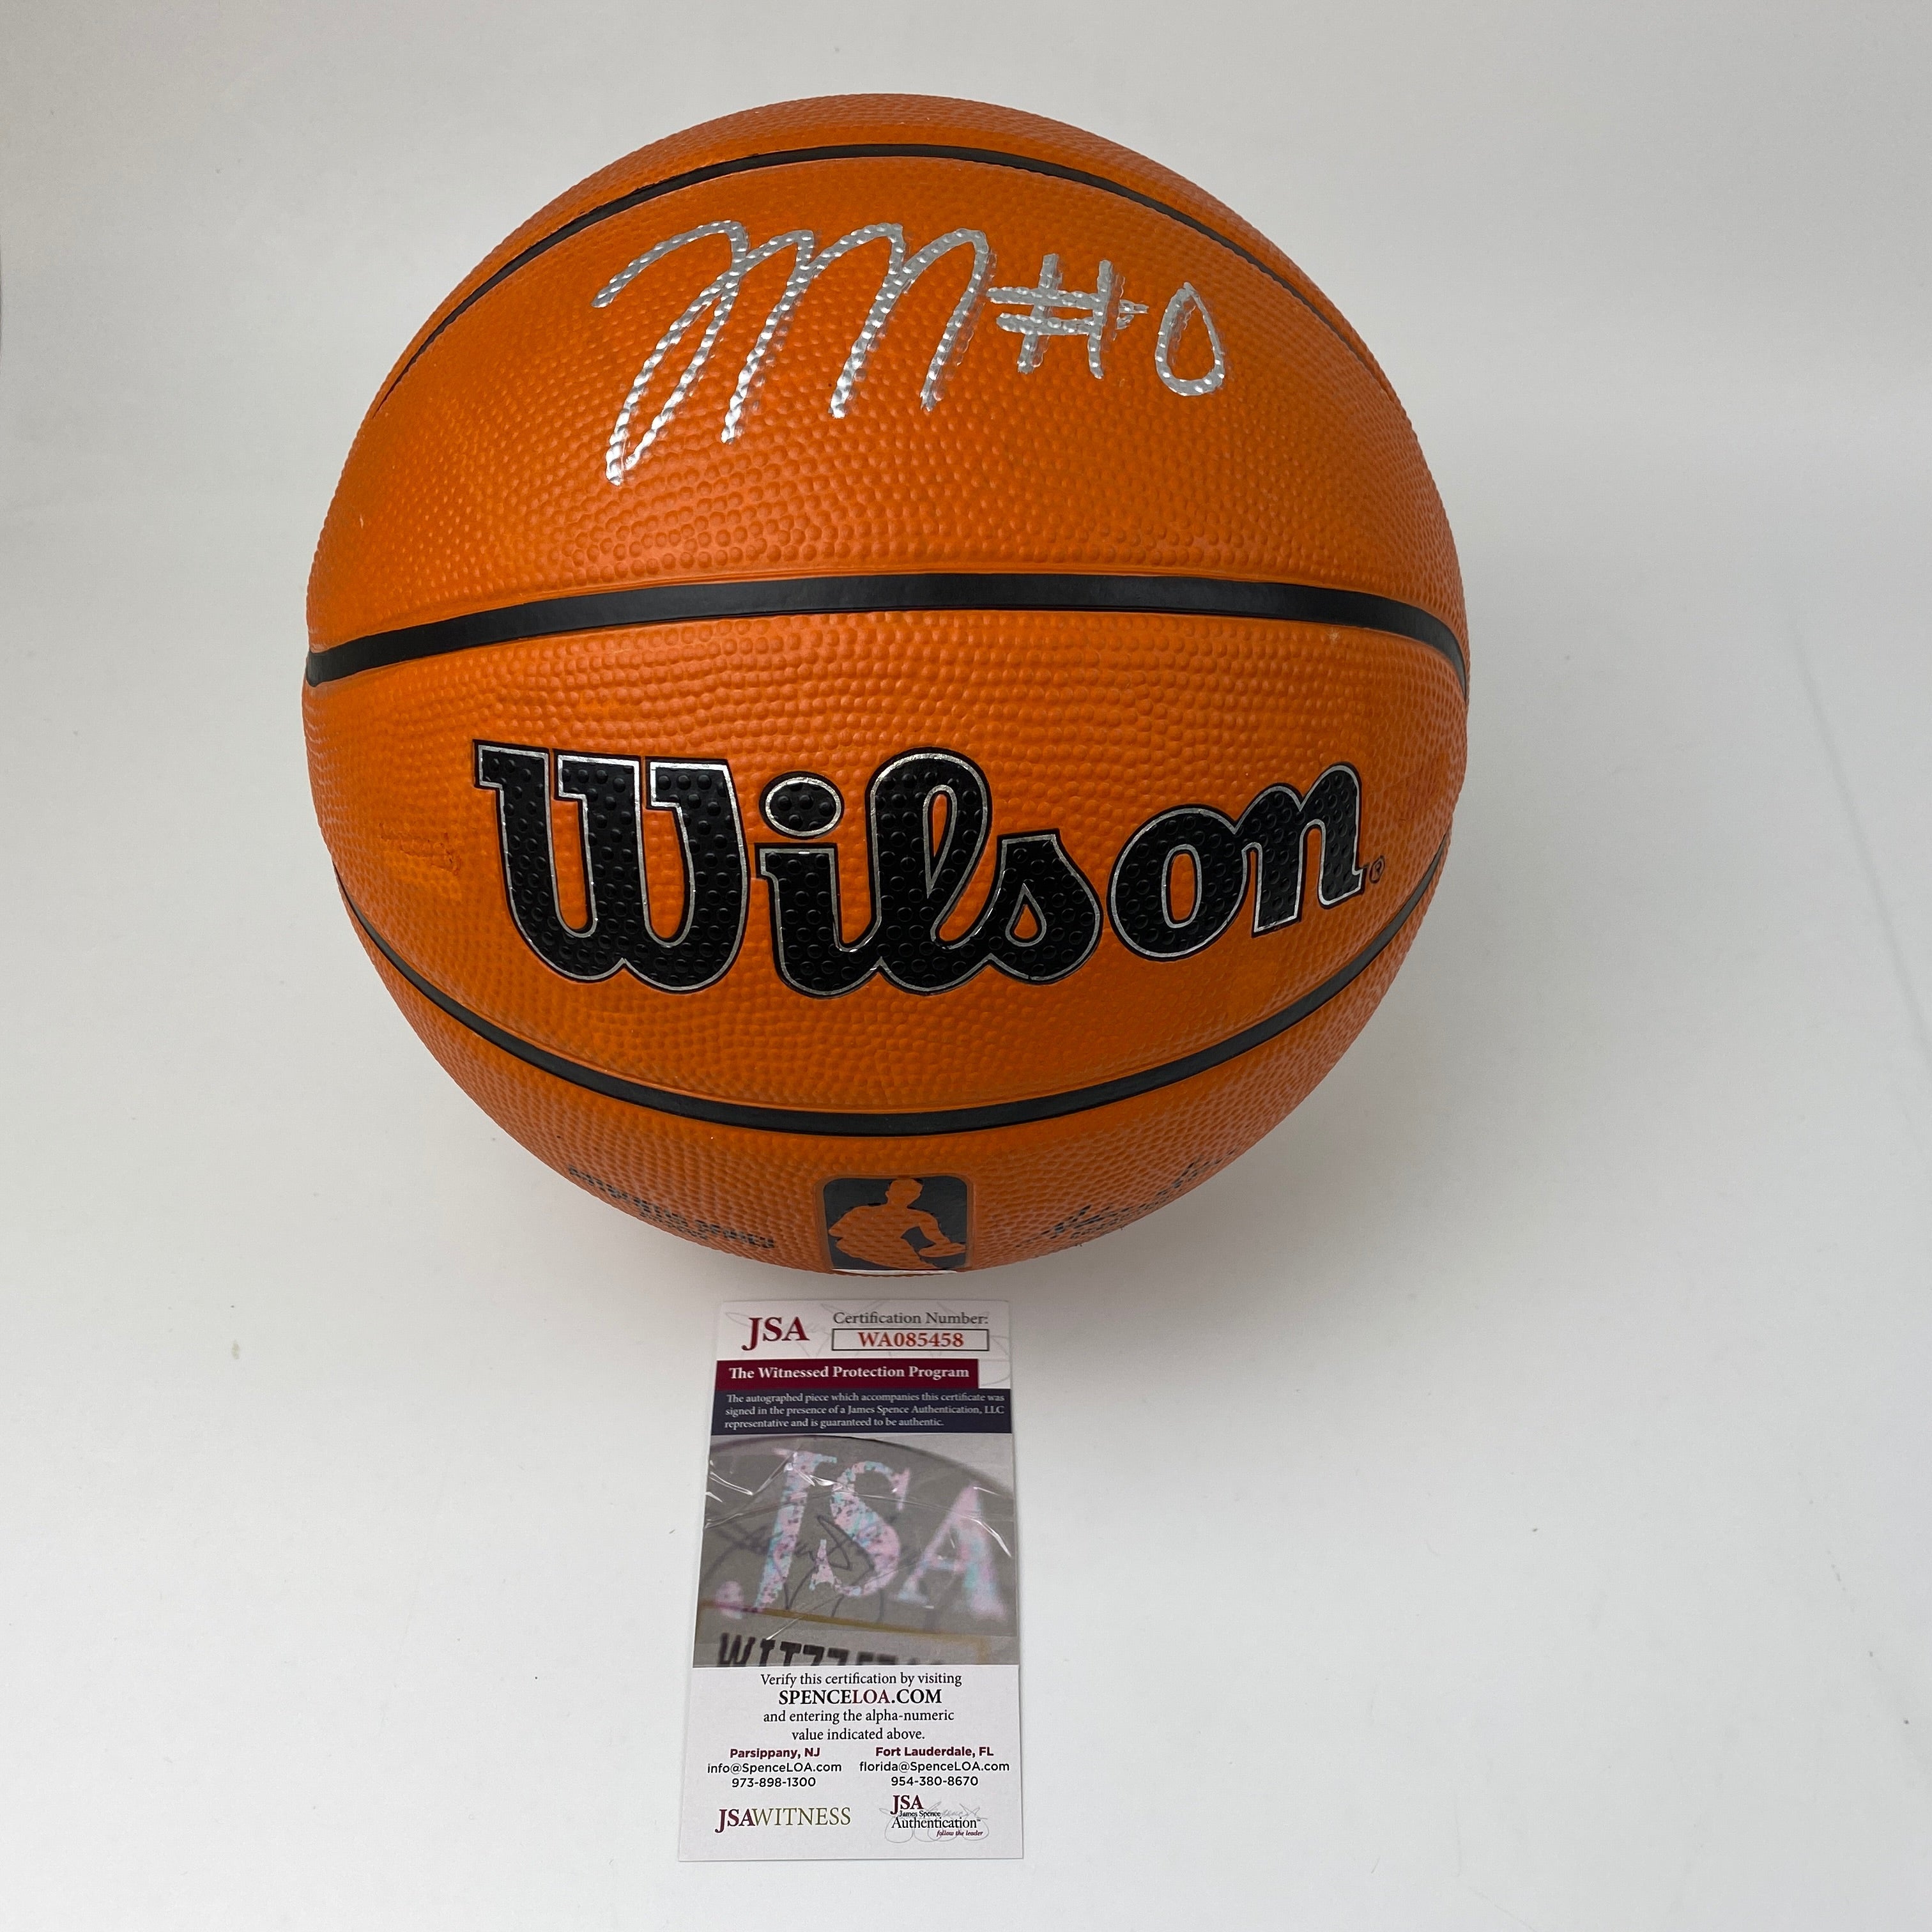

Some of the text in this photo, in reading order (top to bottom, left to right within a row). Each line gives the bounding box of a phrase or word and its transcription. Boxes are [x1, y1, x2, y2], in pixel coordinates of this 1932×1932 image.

[475, 740, 1366, 999] Wilson
[833, 1312, 988, 1324] Certification Number:
[741, 1317, 809, 1351] JSA
[857, 1331, 964, 1348] WA085458
[729, 1366, 969, 1380] The Witnessed Protection Program
[726, 1394, 744, 1402] The
[746, 1393, 802, 1404] autographed
[805, 1394, 829, 1404] piece
[831, 1393, 859, 1401] which
[861, 1393, 919, 1403] accompanies
[922, 1393, 939, 1401] this
[940, 1393, 986, 1401] certificate
[726, 1406, 755, 1418] signed
[758, 1407, 767, 1415] in
[770, 1406, 785, 1414] the
[786, 1407, 826, 1416] presence
[829, 1405, 839, 1414] of
[848, 1406, 875, 1414] James
[877, 1406, 909, 1415] Spence
[910, 1405, 983, 1414] Authentication,
[984, 1406, 1004, 1414] LLC
[724, 1419, 789, 1430] representative
[791, 1418, 808, 1427] and
[820, 1418, 871, 1429] guaranteed
[885, 1418, 896, 1426] be
[898, 1418, 944, 1426] authentic.
[761, 1672, 962, 1688] Verify this certification by visiting
[779, 1689, 942, 1705] SPENCELOA.COM
[763, 1709, 954, 1724] and entering the alpha-numeric
[792, 1728, 925, 1740] value indicated above.
[730, 1748, 820, 1759] Parsippany, NJ
[876, 1747, 994, 1758] Fort Lauderdale, FL
[707, 1763, 841, 1774] info@SpenceLOA.com
[859, 1761, 1009, 1773] florida@SpenceLOA.com
[732, 1777, 816, 1788] 973-898-1300
[891, 1776, 979, 1786] 954-380-8670
[890, 1795, 924, 1814] JSA
